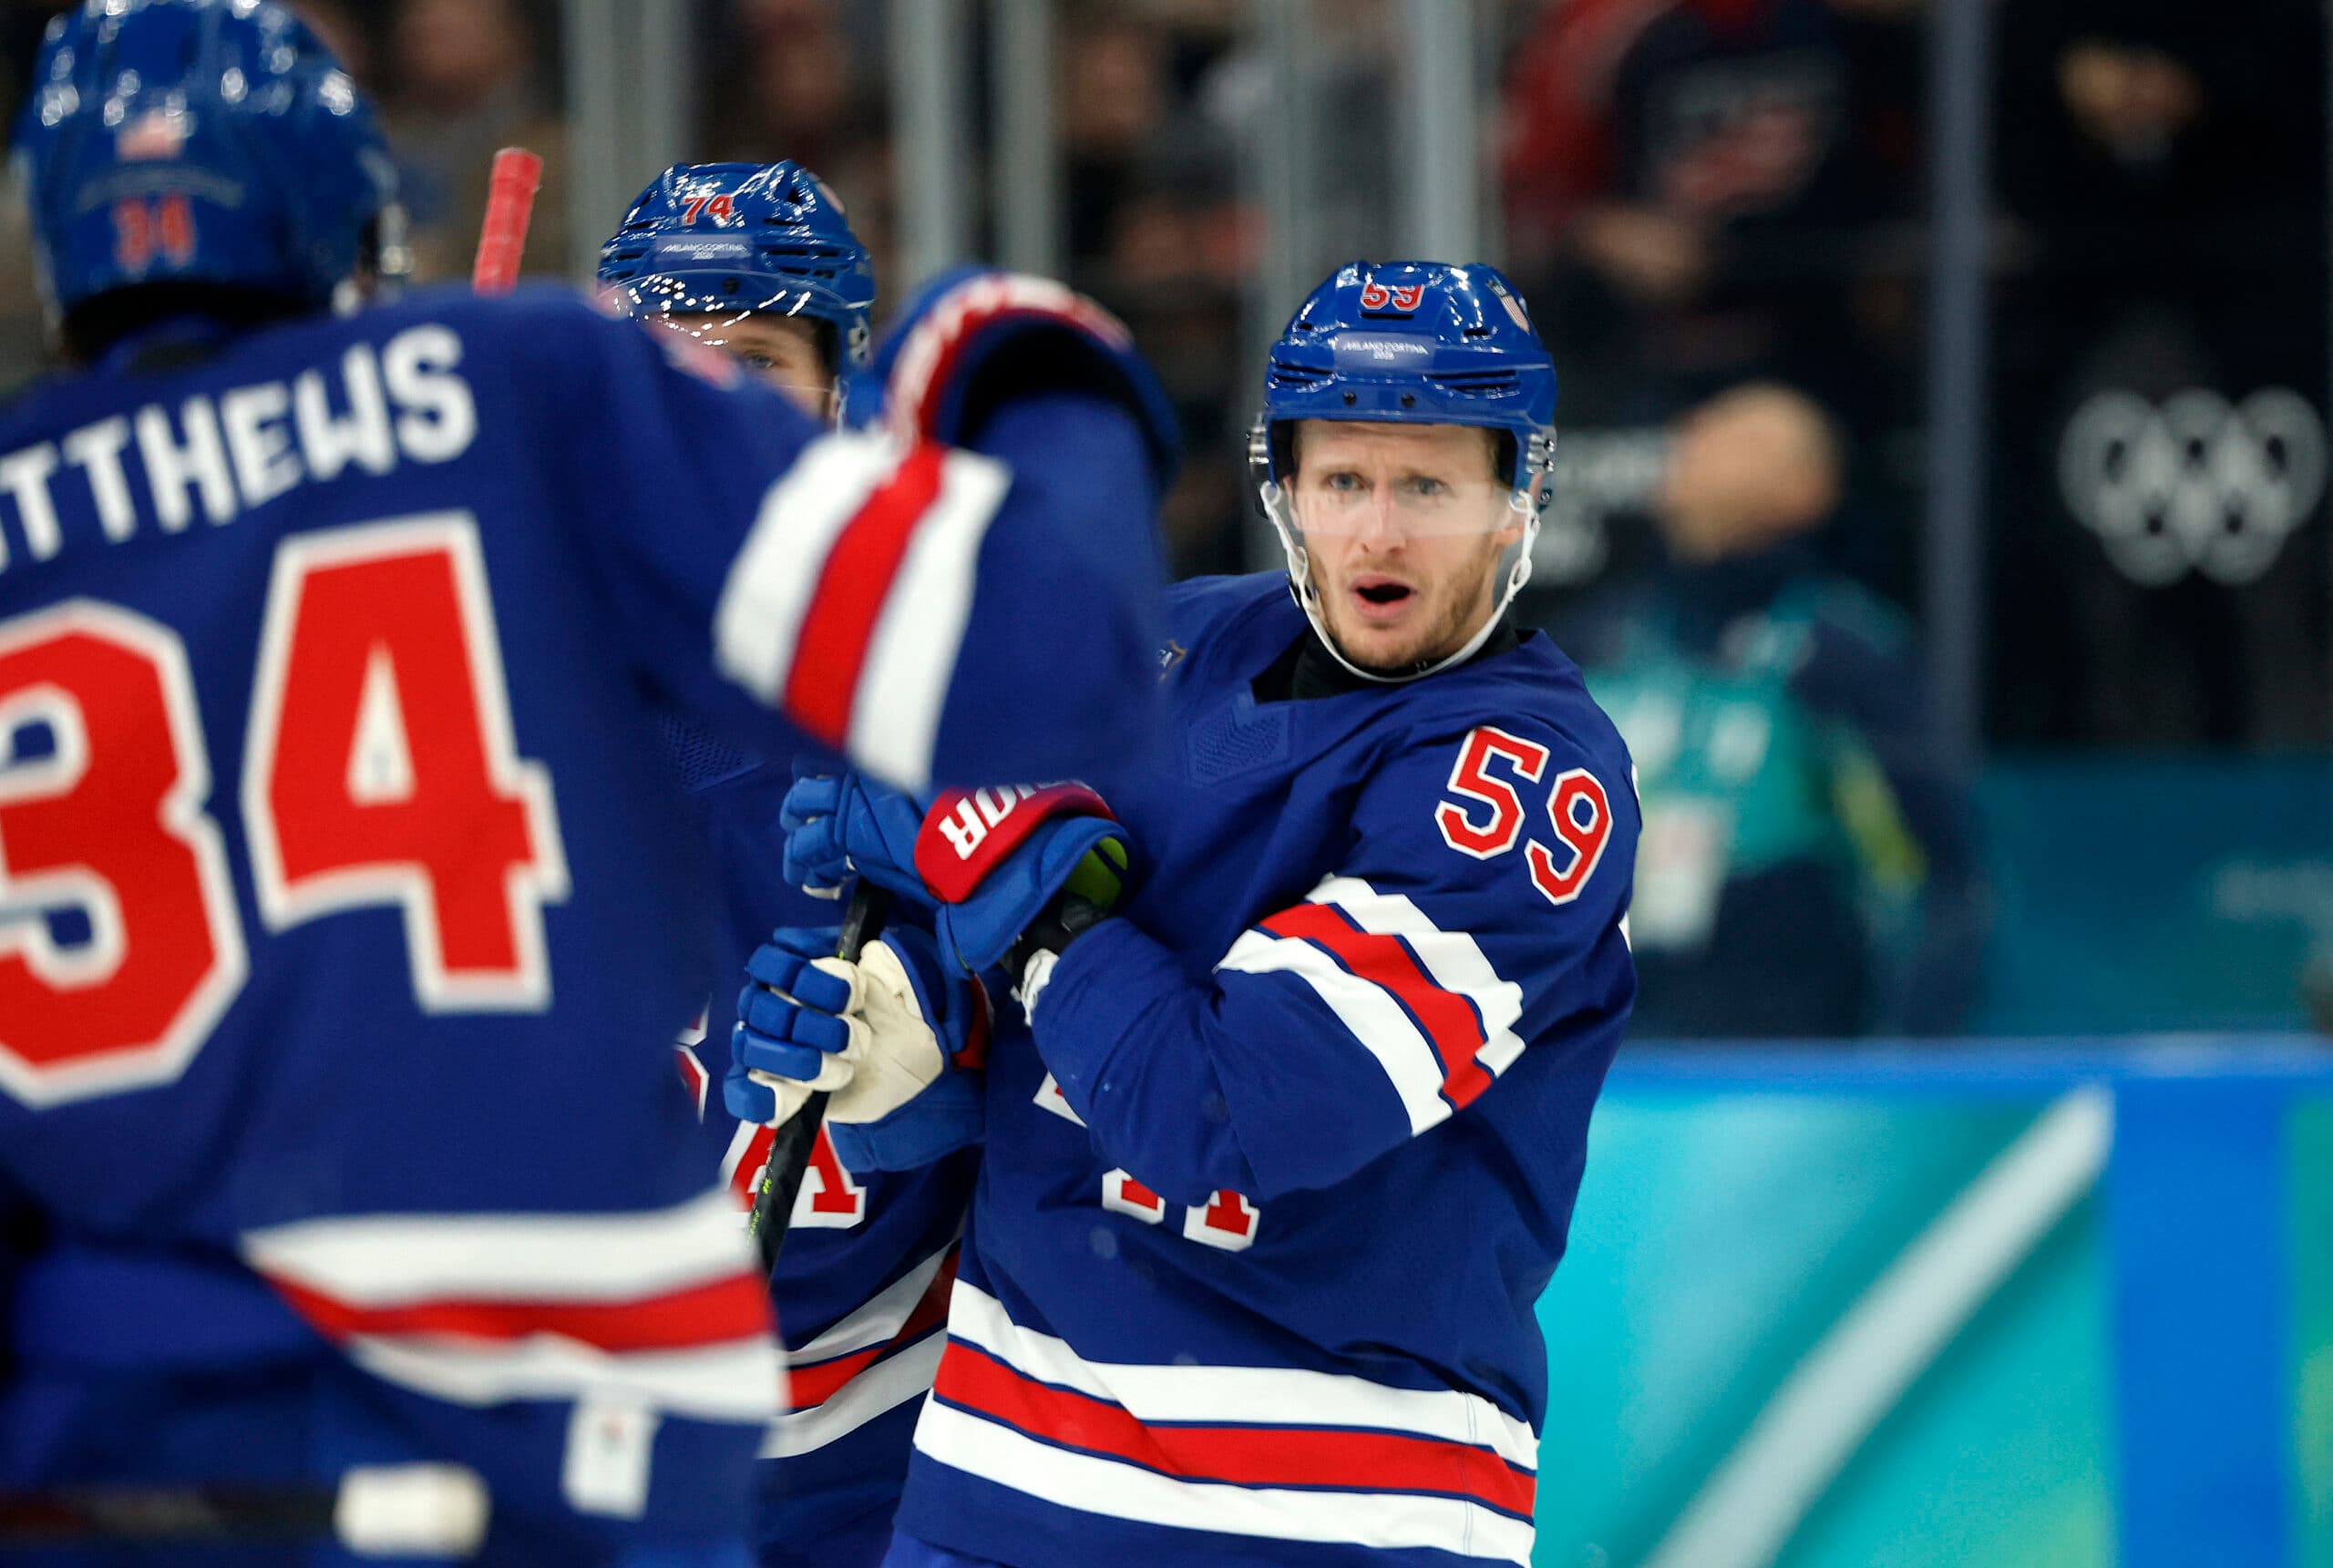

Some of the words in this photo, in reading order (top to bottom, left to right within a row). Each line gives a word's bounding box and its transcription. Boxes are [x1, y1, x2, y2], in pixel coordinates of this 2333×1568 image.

[681, 193, 735, 226] 74
[0, 323, 478, 569] TTHEWS
[0, 508, 571, 1109] 34
[1434, 725, 1613, 906] 59
